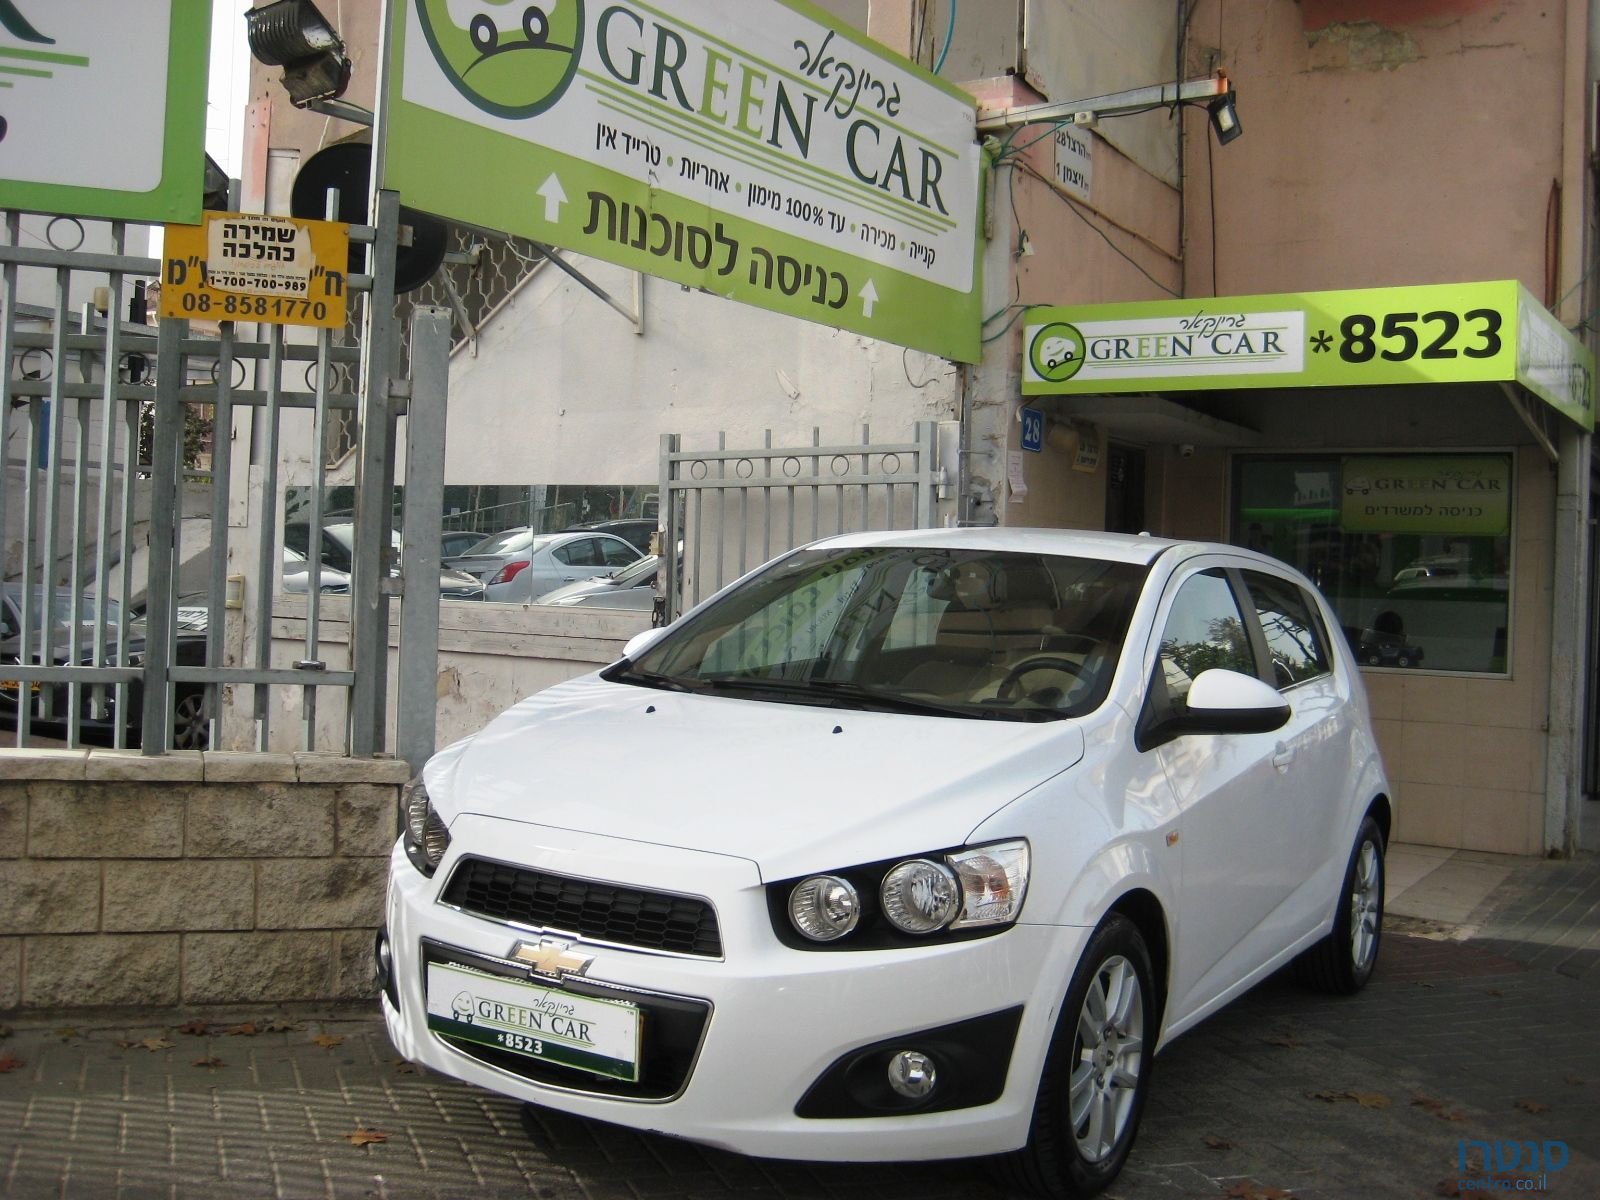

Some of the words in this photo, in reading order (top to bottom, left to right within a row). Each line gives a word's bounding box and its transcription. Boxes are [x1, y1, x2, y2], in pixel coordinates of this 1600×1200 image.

[794, 30, 901, 119] גרינקאר
[596, 5, 818, 159] GREEN
[846, 119, 949, 216] CAR
[596, 122, 617, 150] אין
[622, 131, 661, 166] טרייד
[680, 156, 730, 193] אחריות
[1063, 165, 1084, 188] ויצמן
[747, 182, 782, 212] מימון
[786, 197, 824, 226] 100%
[828, 211, 845, 233] עד
[223, 223, 296, 243] שמירה
[582, 191, 739, 276] לסוכנות
[860, 223, 896, 250] מכירה
[222, 242, 295, 261] כהלכה
[909, 241, 936, 269] קנייה
[210, 275, 307, 291] 1-700-700-989
[750, 247, 849, 310] כניסה
[183, 293, 326, 320] 08-8581770
[1179, 310, 1247, 338] גרינקאר
[1090, 335, 1194, 360] GREEN
[1211, 331, 1285, 355] CAR
[1024, 417, 1040, 443] 28
[1456, 478, 1501, 491] CAR
[1365, 504, 1433, 516] למשרדים
[1439, 505, 1482, 517] כניסה
[533, 991, 575, 1017] גרינקאר
[478, 1001, 542, 1029] GREEN
[551, 1016, 592, 1042] CAR
